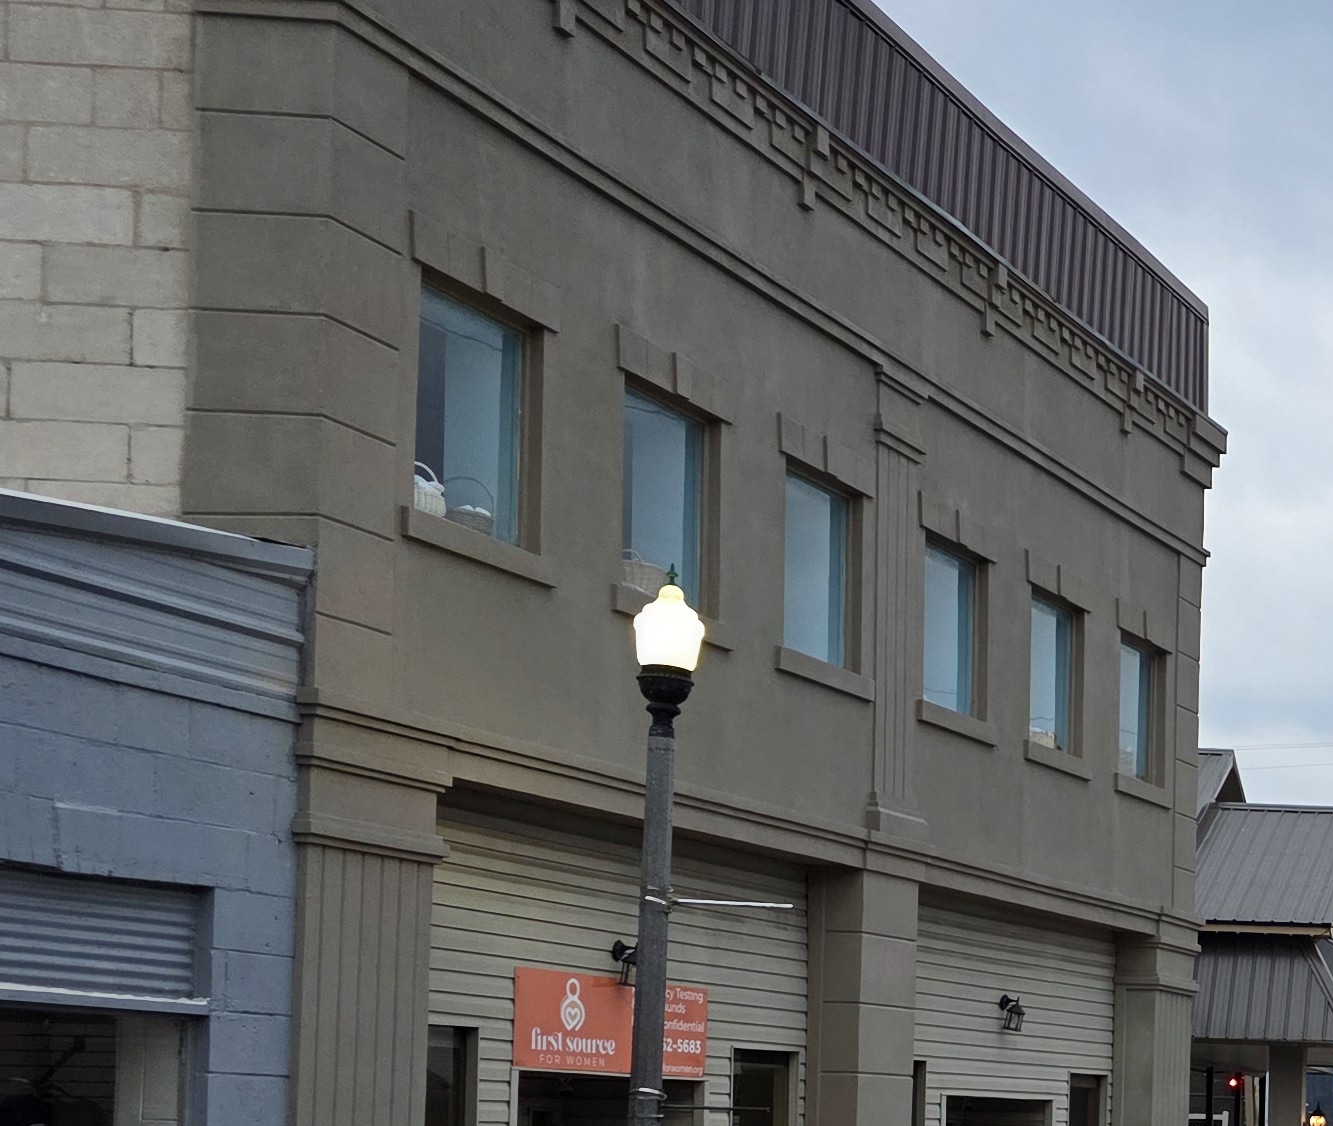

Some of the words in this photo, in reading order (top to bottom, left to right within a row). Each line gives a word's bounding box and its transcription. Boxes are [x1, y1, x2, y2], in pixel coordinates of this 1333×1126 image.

[676, 988, 704, 1004] Testing
[664, 1019, 704, 1032] onfidential
[531, 1026, 563, 1051] first
[566, 1036, 616, 1055] source
[539, 1053, 561, 1064] FOR
[566, 1055, 606, 1067] WOMEN
